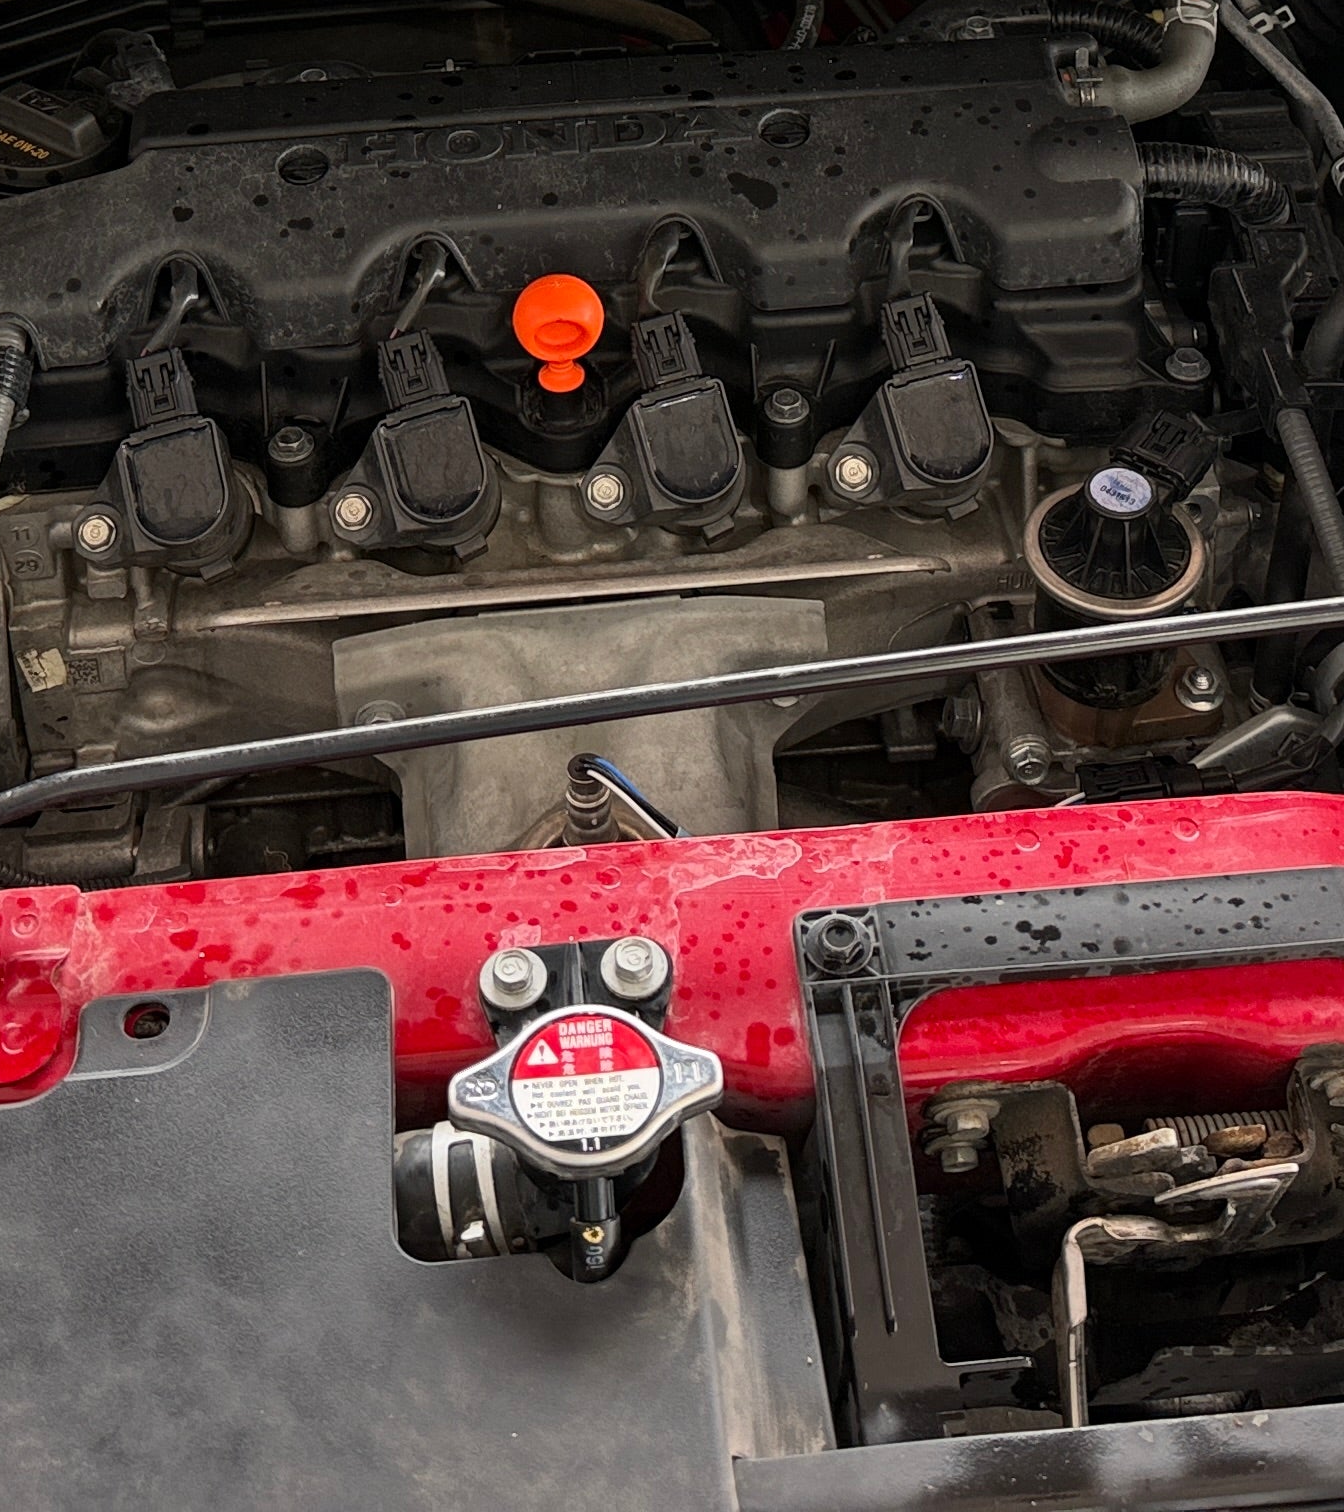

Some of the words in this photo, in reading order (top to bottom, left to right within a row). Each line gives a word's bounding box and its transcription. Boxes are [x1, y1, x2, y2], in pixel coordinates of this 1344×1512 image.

[13, 139, 50, 159] 0W-20
[10, 527, 30, 542] 11
[14, 558, 39, 574] 29
[559, 1019, 613, 1036] DANGER
[559, 1032, 614, 1050] WARNUNG
[559, 1080, 578, 1088] OPEN
[580, 1137, 601, 1152] 1.1
